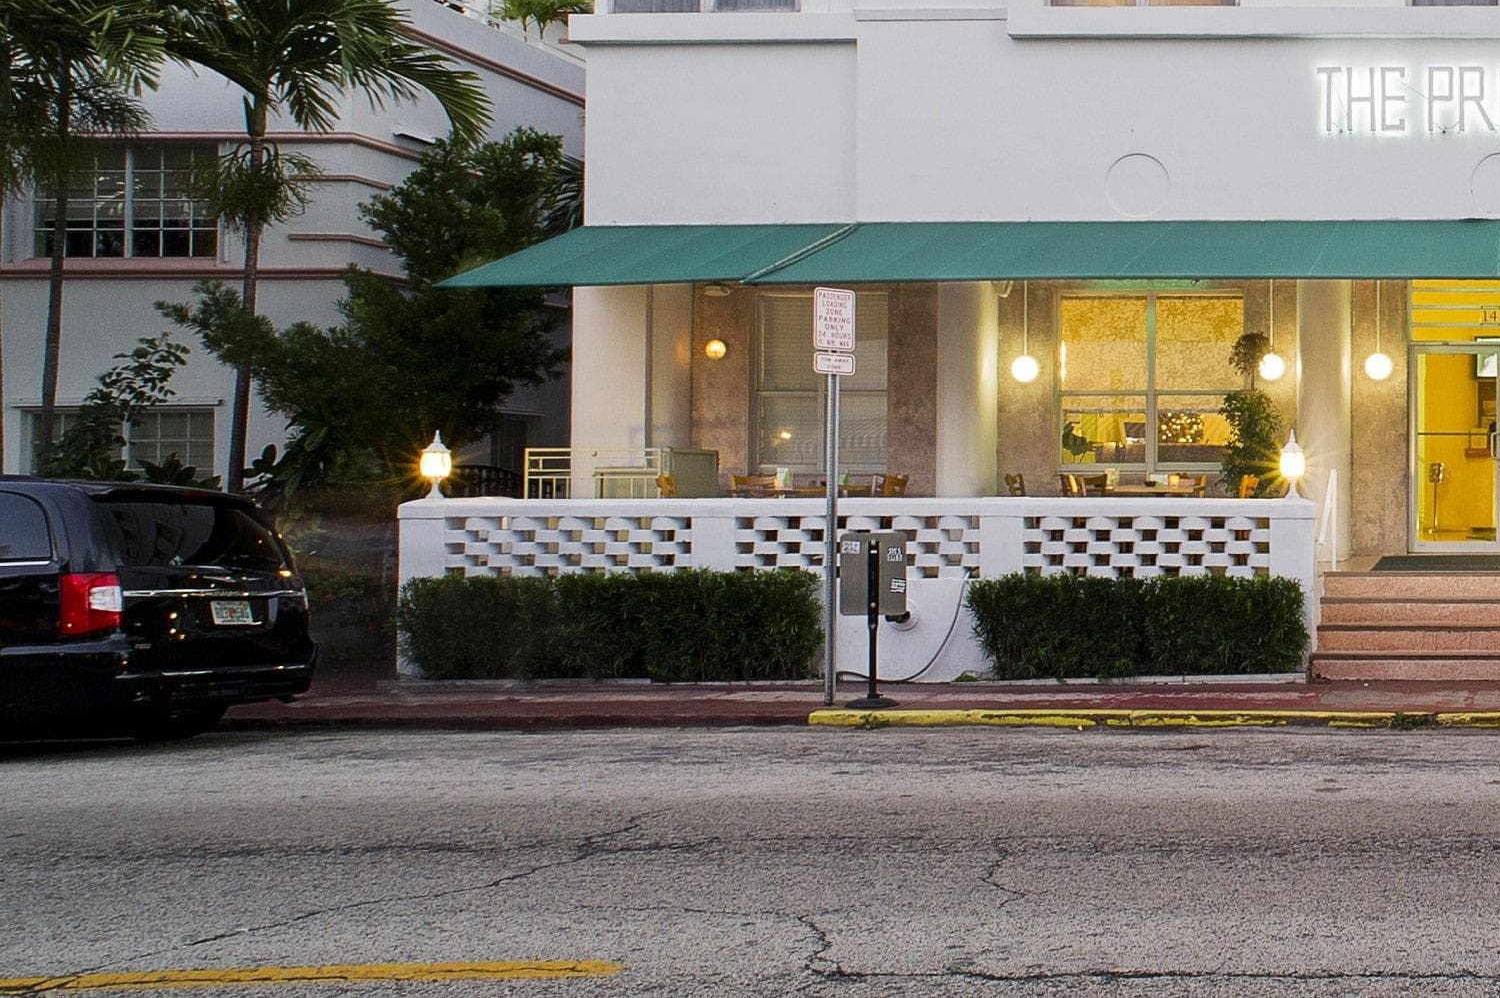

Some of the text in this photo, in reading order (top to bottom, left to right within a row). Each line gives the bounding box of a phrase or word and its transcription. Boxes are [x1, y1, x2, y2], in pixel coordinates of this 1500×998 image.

[1317, 66, 1405, 131] THE
[823, 300, 847, 308] LOADING
[826, 308, 842, 316] ZONE
[819, 316, 851, 324] PARKING
[825, 324, 844, 332] ONLY
